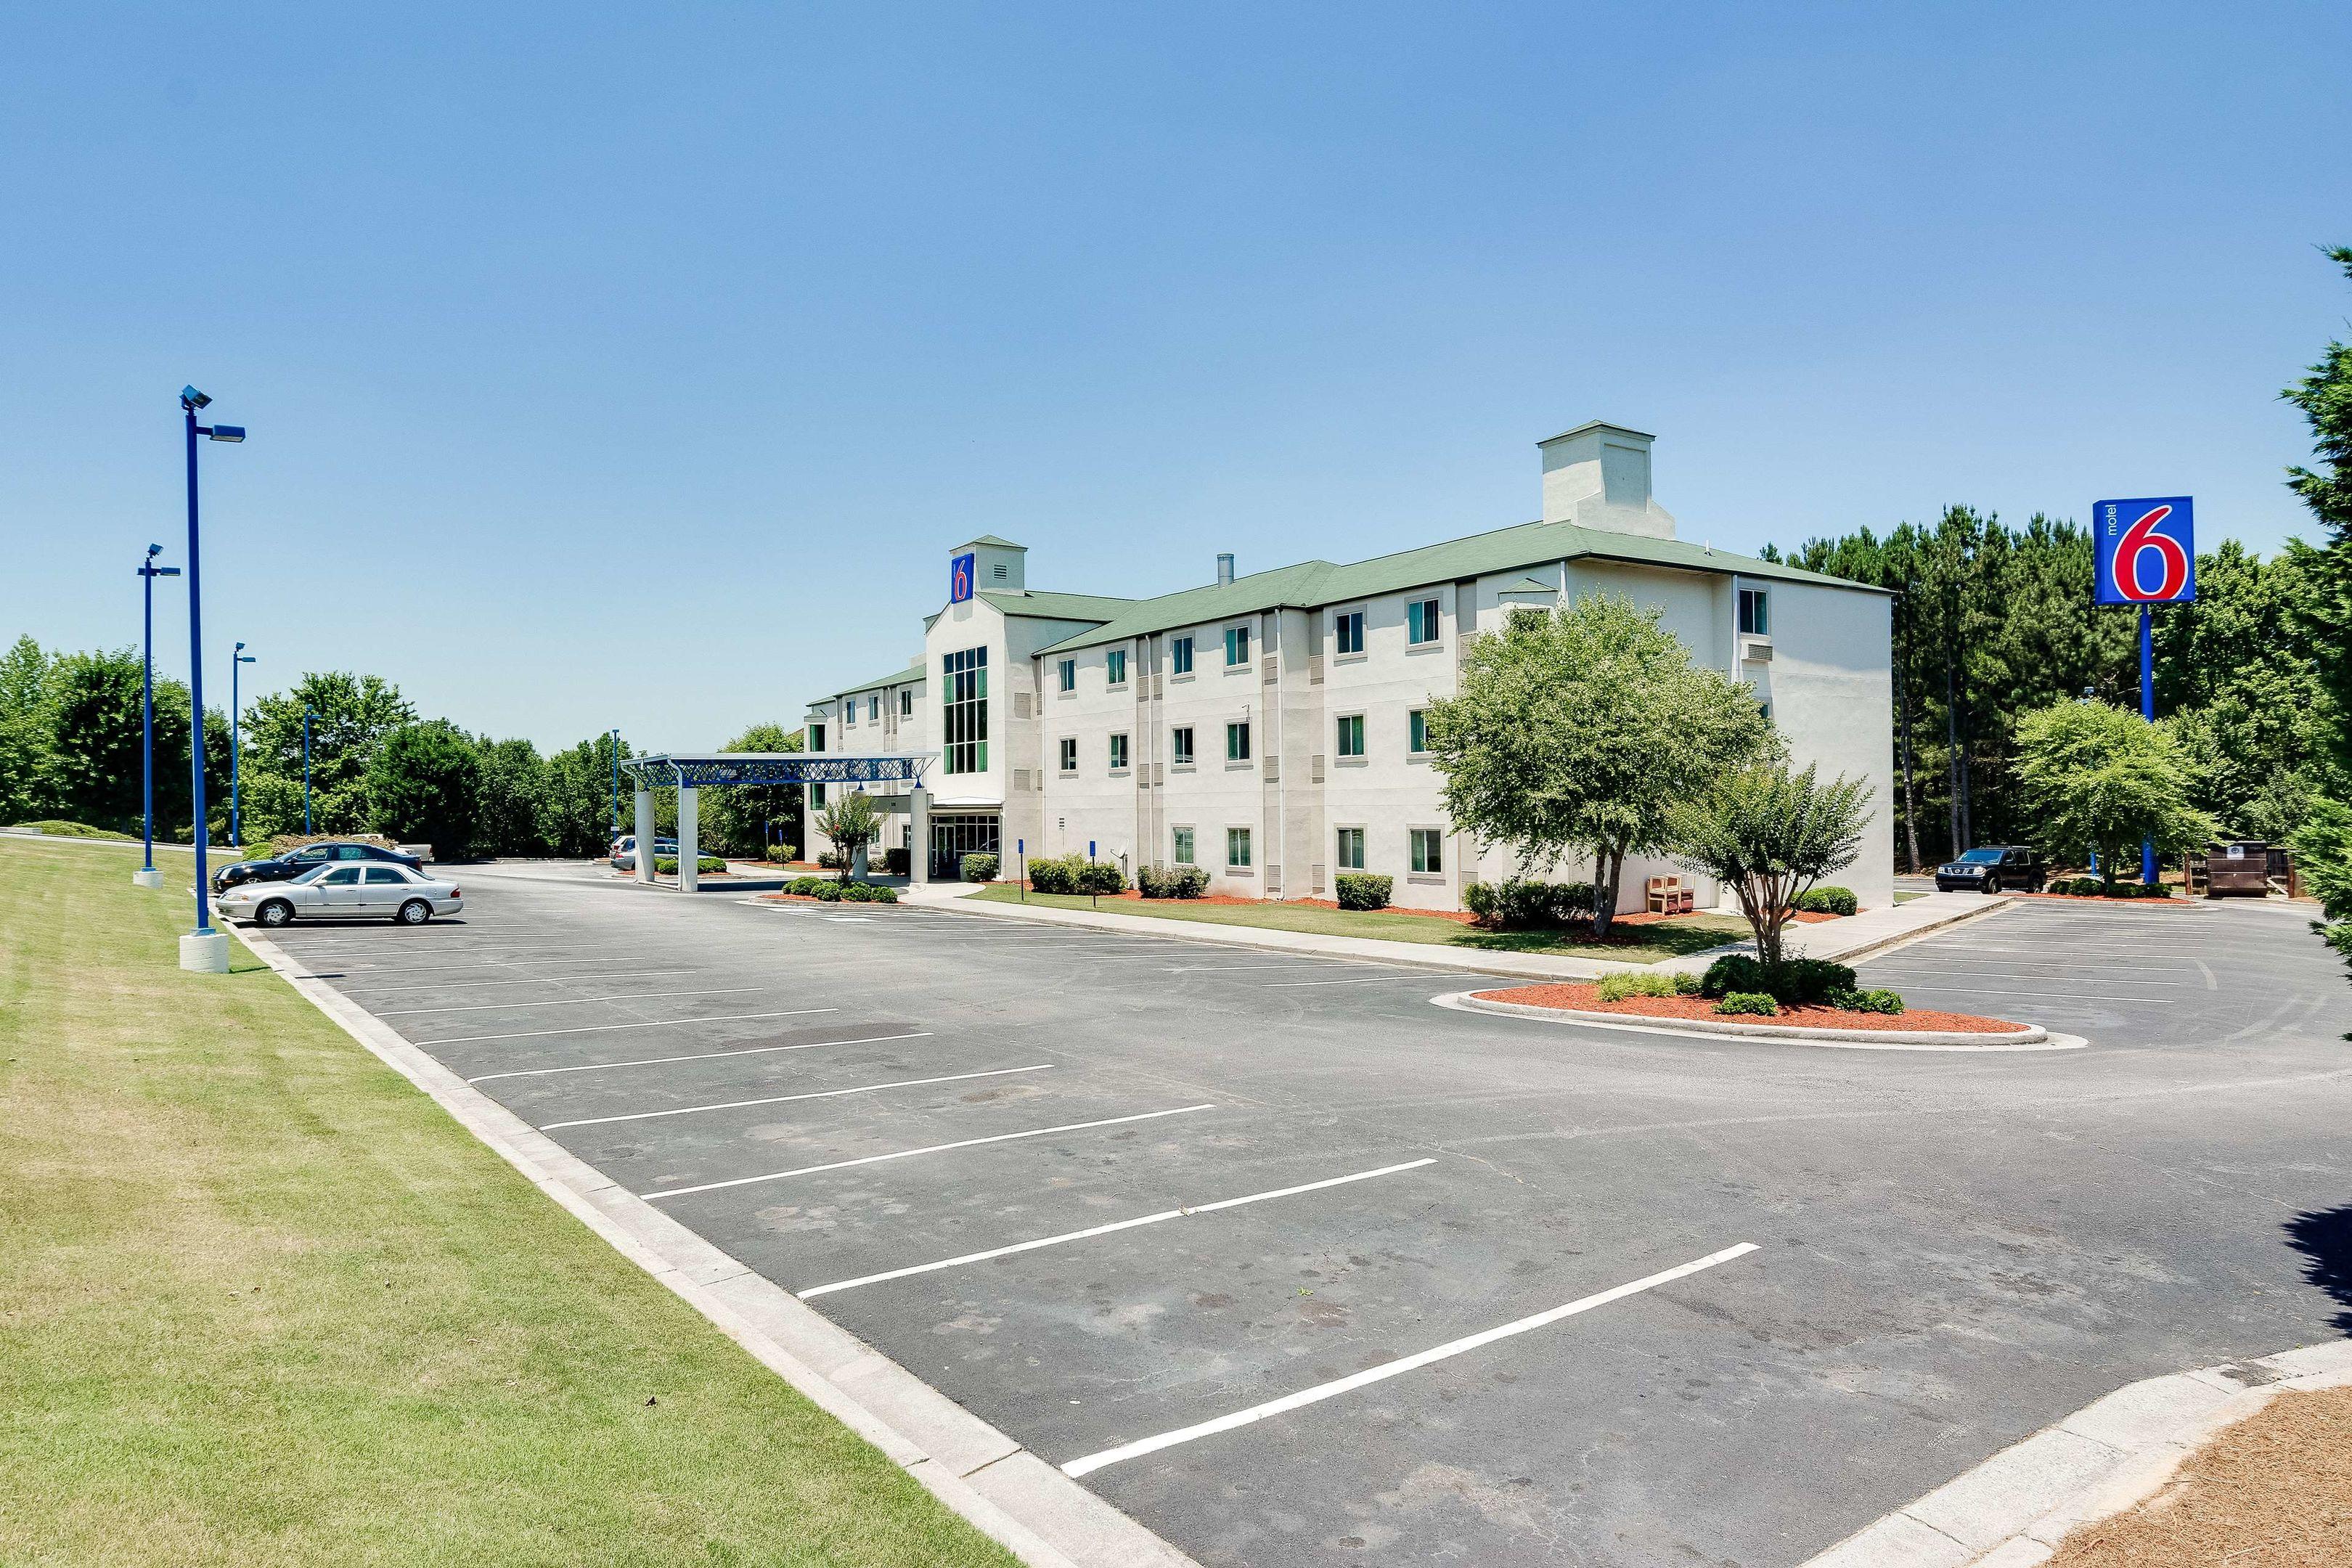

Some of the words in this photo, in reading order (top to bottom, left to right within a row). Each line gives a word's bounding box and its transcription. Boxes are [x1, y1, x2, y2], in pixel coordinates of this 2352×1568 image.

[2105, 505, 2117, 536] motel
[2112, 505, 2189, 600] 6
[955, 560, 967, 600] 6
